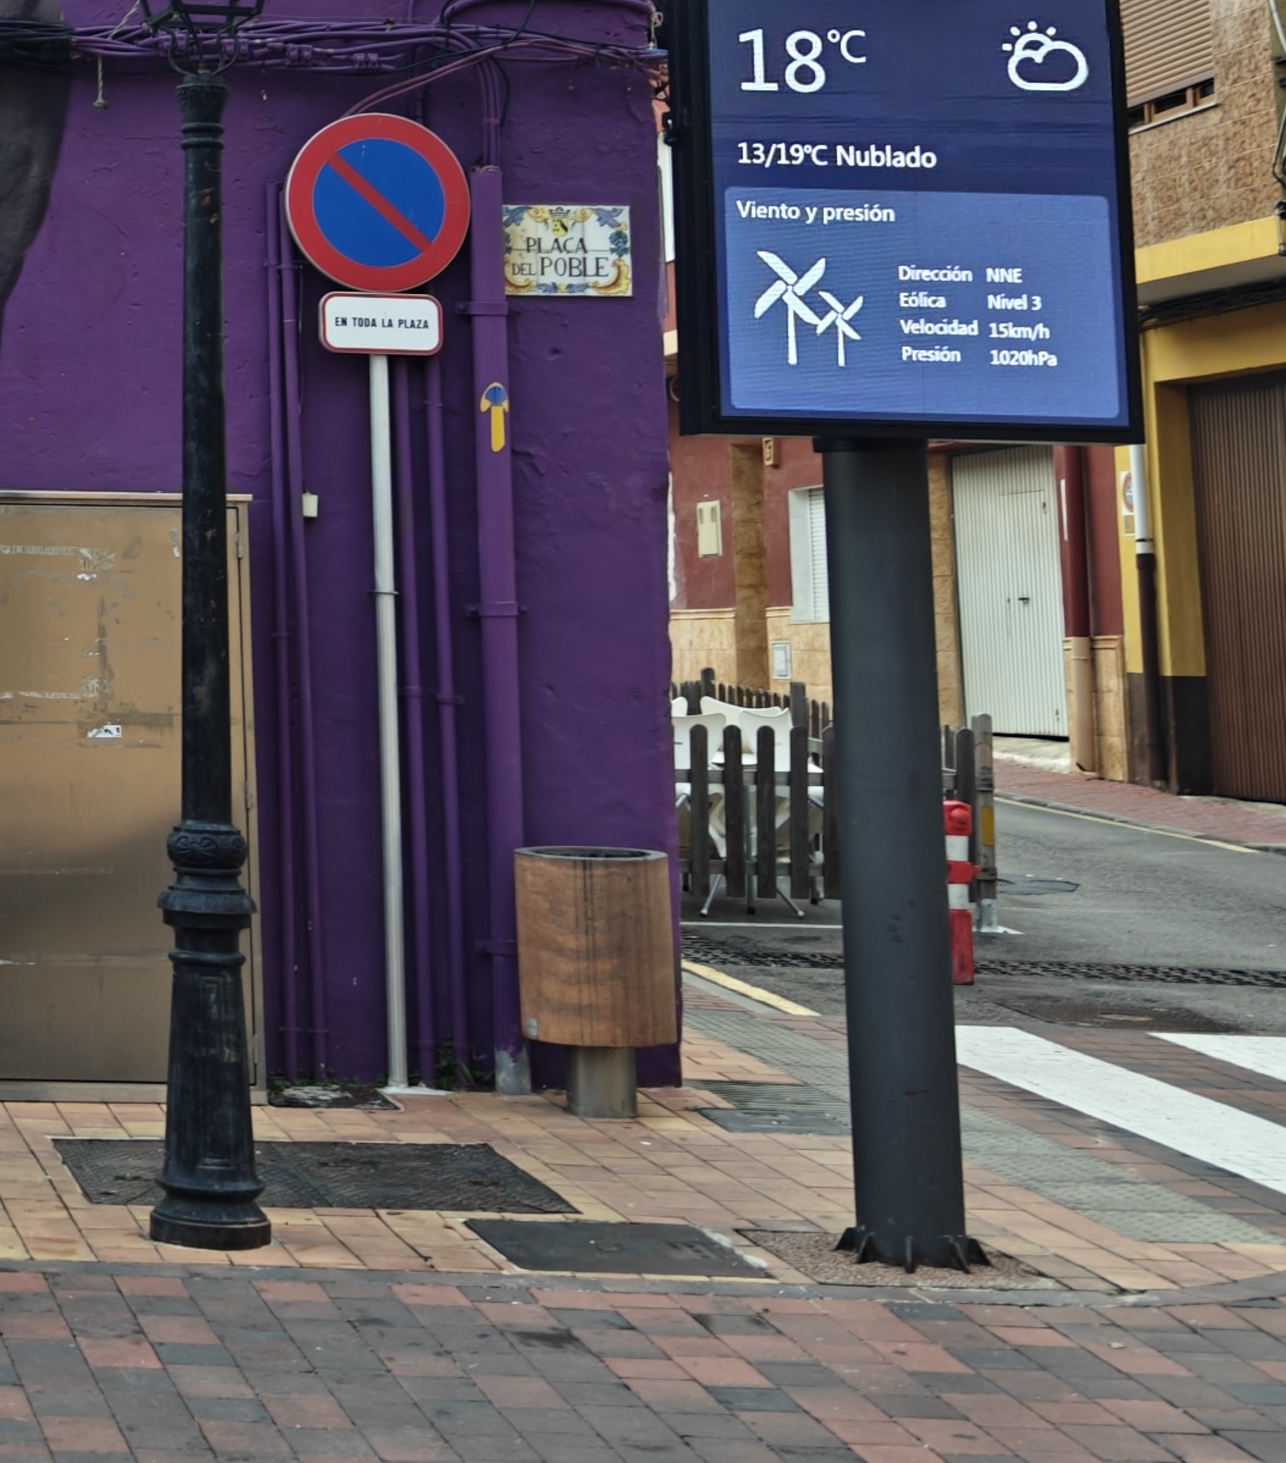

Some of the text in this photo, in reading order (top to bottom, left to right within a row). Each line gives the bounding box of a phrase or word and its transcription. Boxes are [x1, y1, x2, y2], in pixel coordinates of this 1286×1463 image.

[836, 143, 938, 169] Nublado
[736, 199, 896, 225] Viento y presión
[511, 257, 610, 277] DEL POBLE
[897, 264, 1023, 283] Dirección NNE
[899, 291, 1042, 311] Eólica Nivel 3
[334, 316, 429, 329] EN TODA LA PLAZA
[899, 318, 1050, 341] Velocidad 15km/h
[901, 345, 1058, 366] Presión 1020hPa
